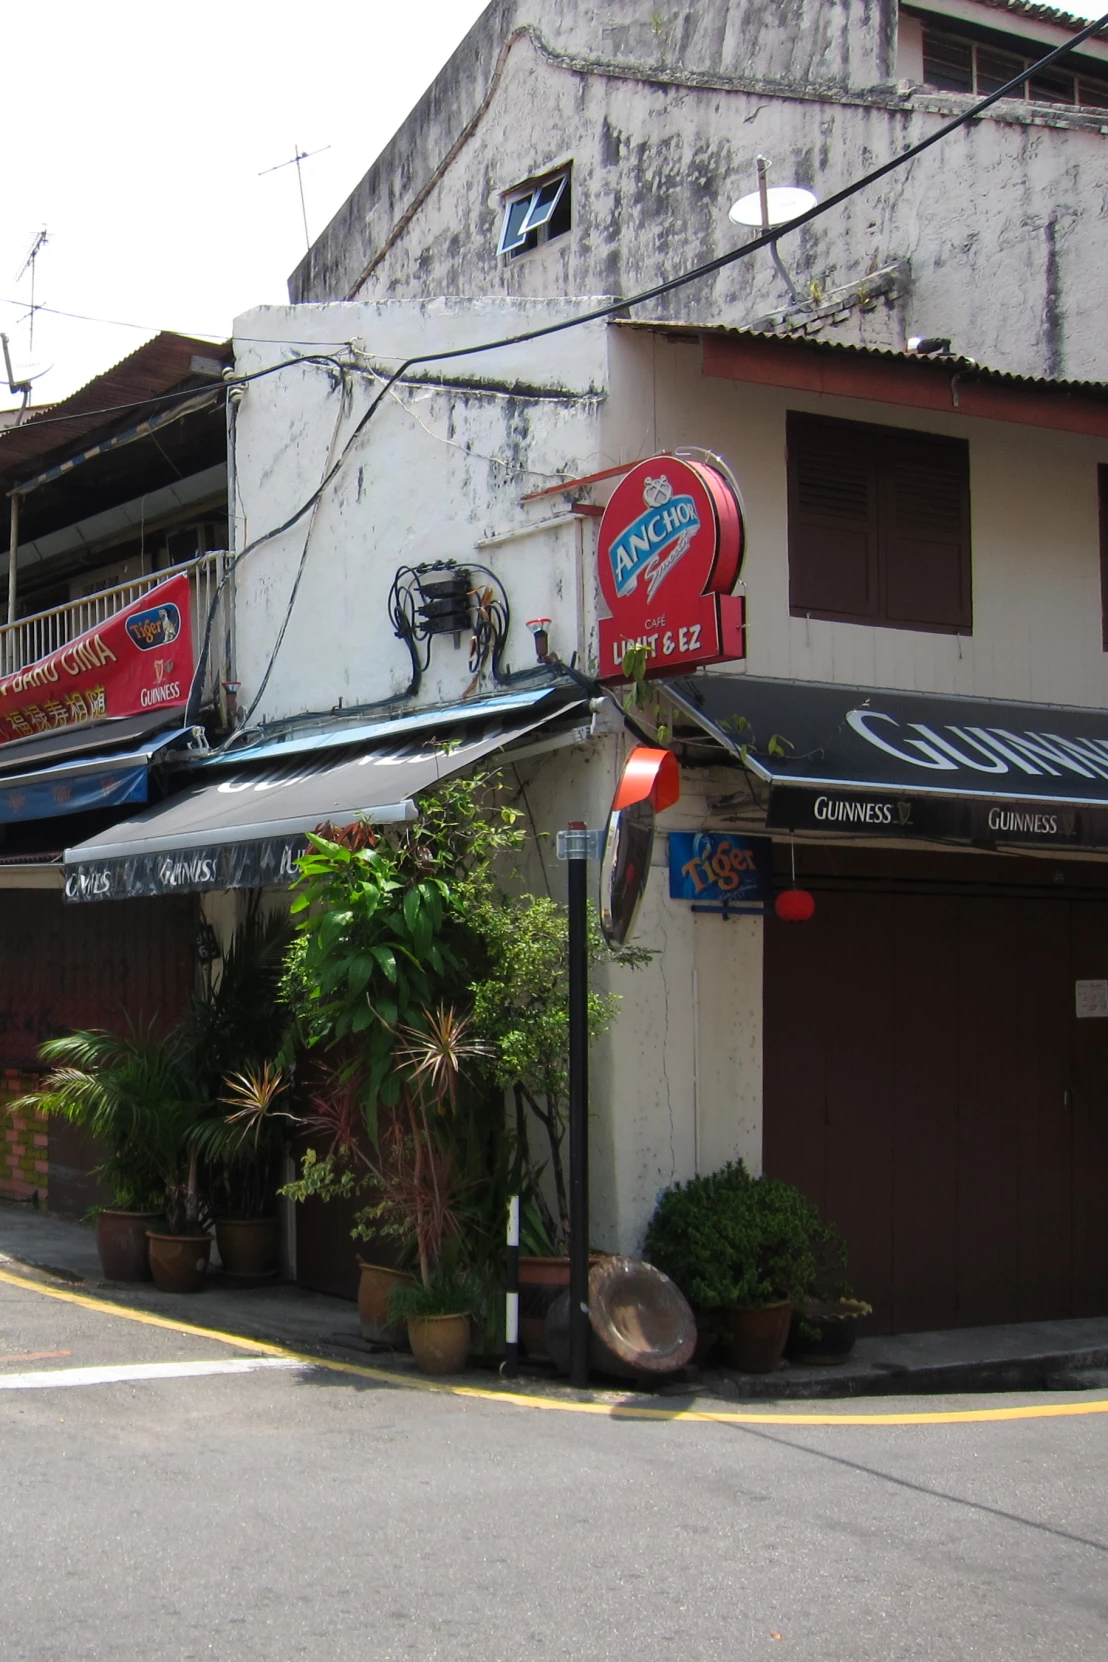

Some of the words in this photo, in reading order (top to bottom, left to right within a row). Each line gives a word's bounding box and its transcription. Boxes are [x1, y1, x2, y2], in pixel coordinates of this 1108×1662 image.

[616, 502, 699, 583] ANCHOR
[130, 619, 163, 644] Tiger
[644, 613, 668, 630] CAFÉ
[662, 631, 676, 655] &
[678, 624, 702, 653] EZ
[61, 634, 118, 675] CINA
[140, 681, 181, 708] GUINNESS
[814, 796, 892, 824] GUINNESS
[988, 807, 1058, 835] GUINNESS
[681, 841, 757, 894] Tiger
